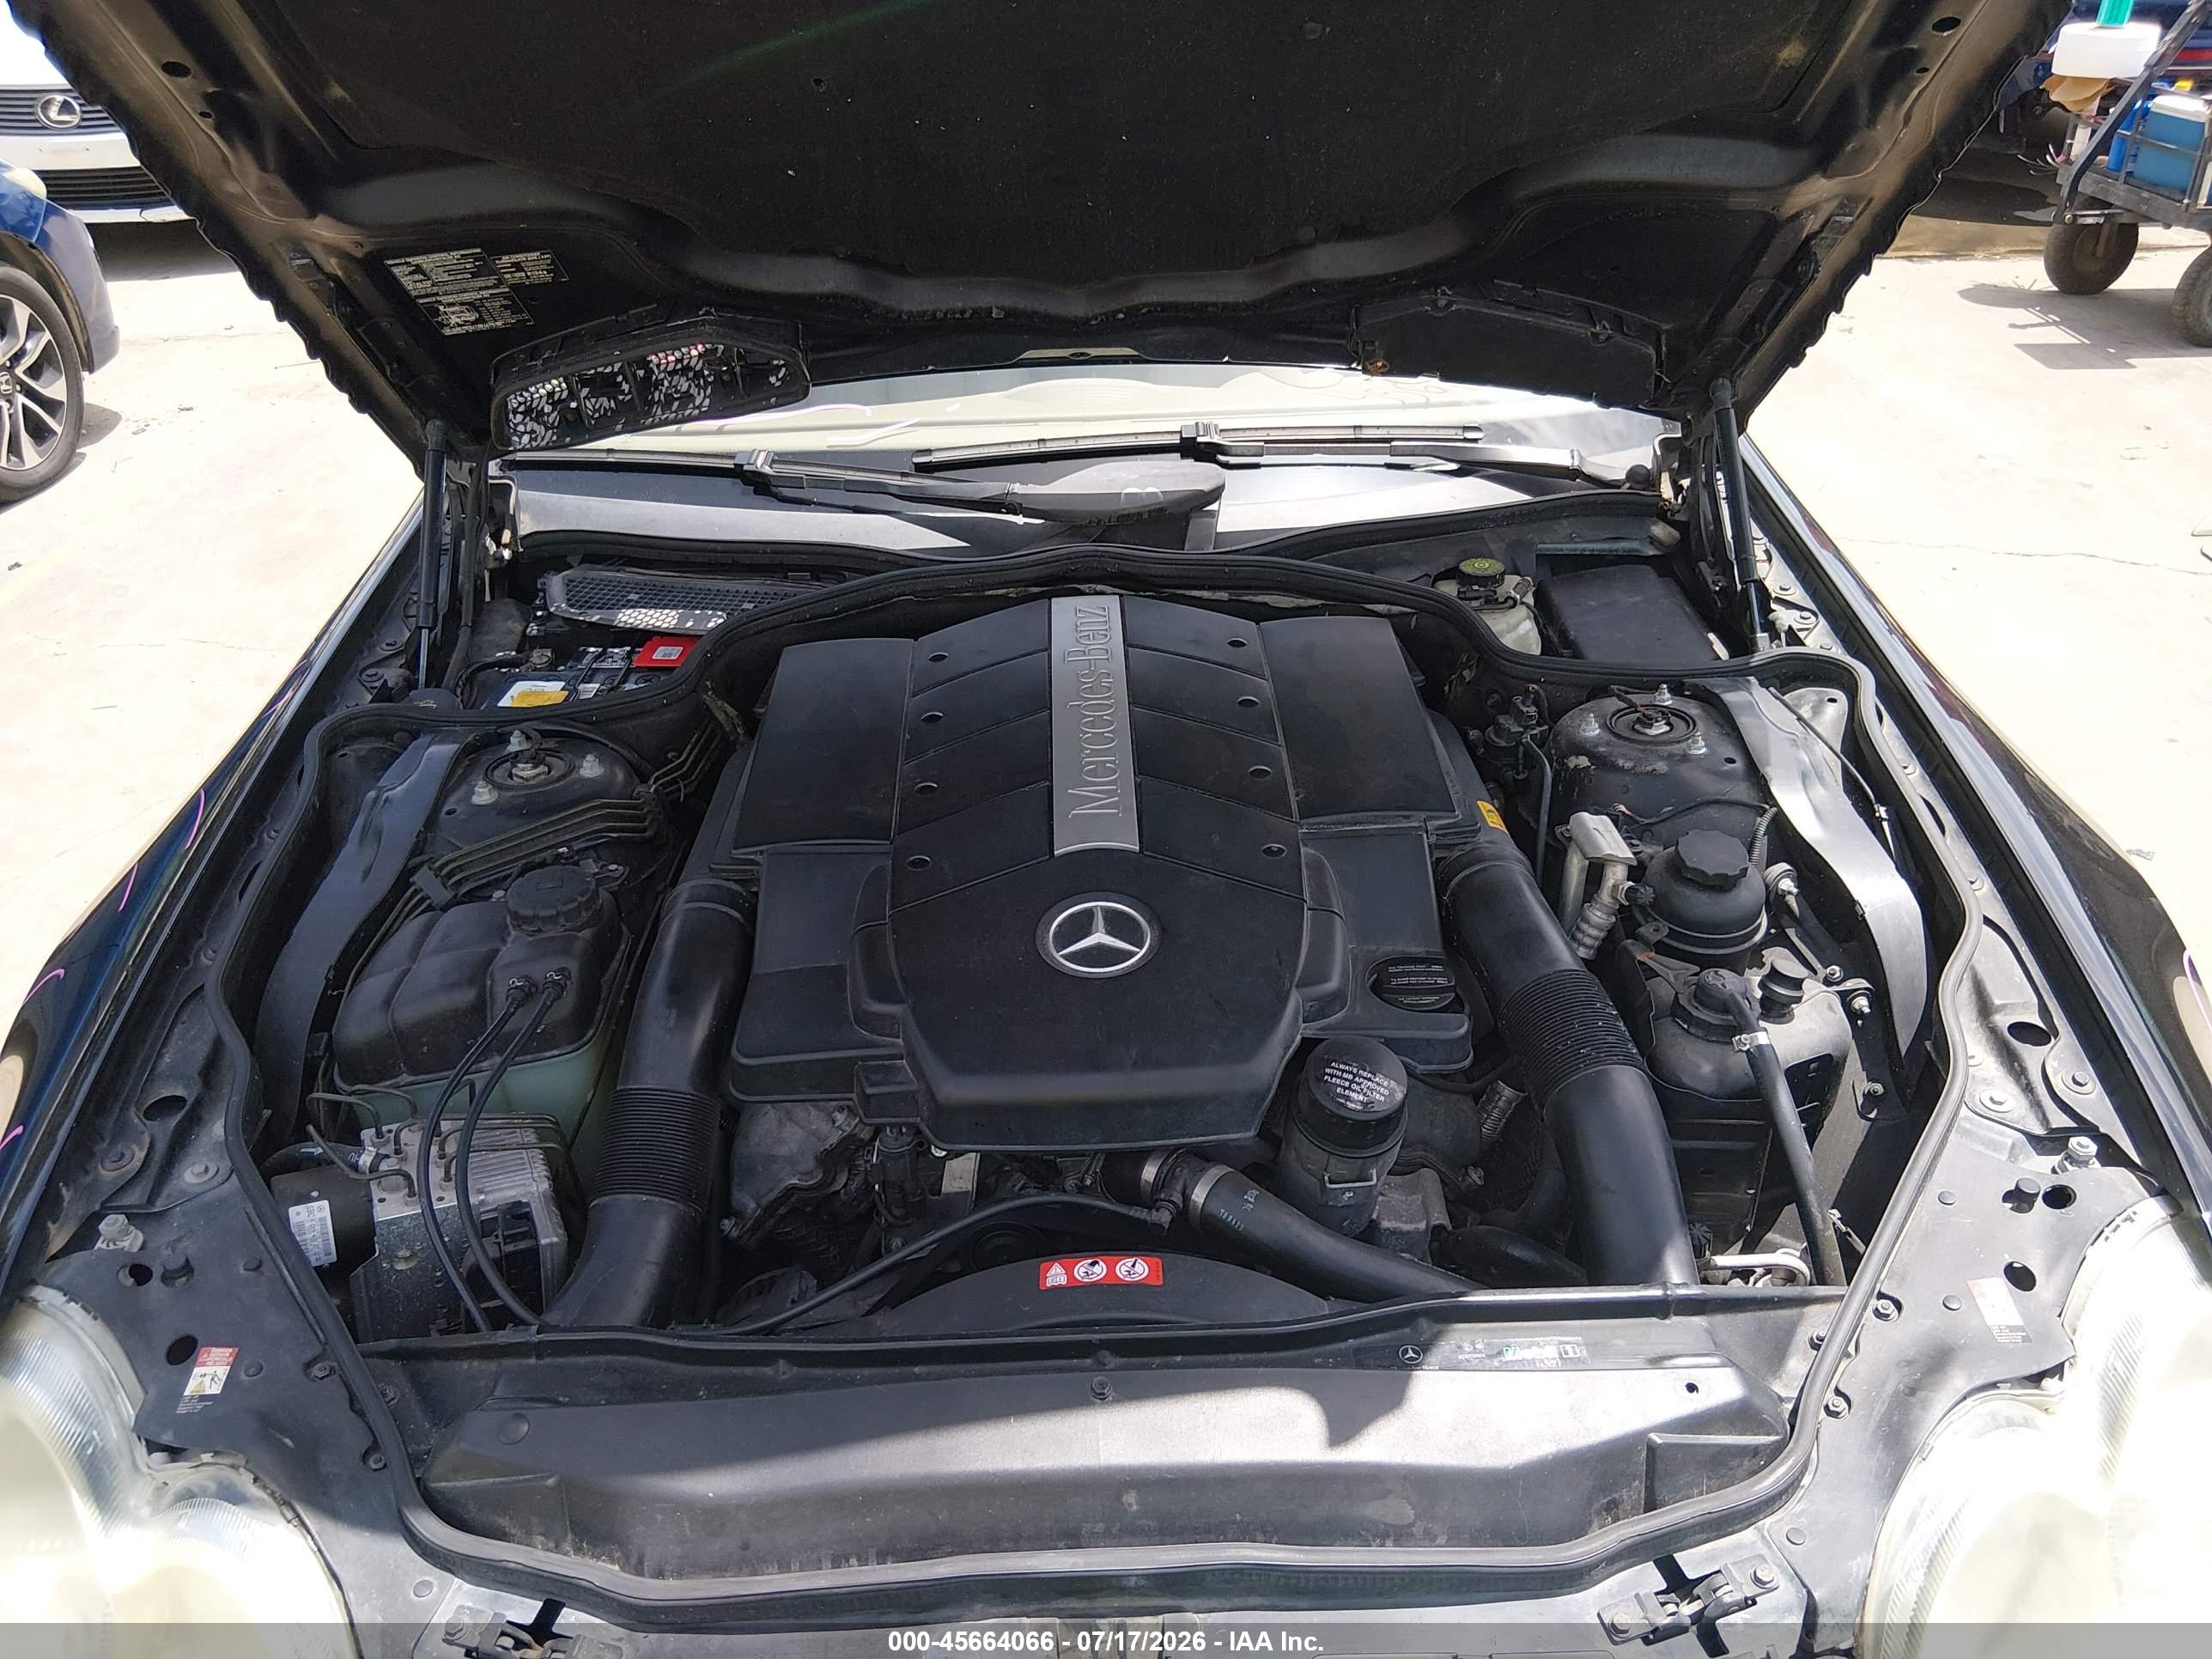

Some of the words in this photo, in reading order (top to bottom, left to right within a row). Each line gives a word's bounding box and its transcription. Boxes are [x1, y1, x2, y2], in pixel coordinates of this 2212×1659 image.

[1064, 605, 1122, 817] Mercedes-Benz
[1325, 1067, 1342, 1077] WITH
[1354, 1076, 1389, 1096] APPROVED
[1330, 1061, 1358, 1073] ALWAYS
[1358, 1070, 1389, 1087] REPLACE
[1323, 1075, 1350, 1087] FLEECE
[1351, 1084, 1362, 1092] OIL
[1363, 1088, 1385, 1103] FILTER
[1336, 1087, 1367, 1103] ELEMENT
